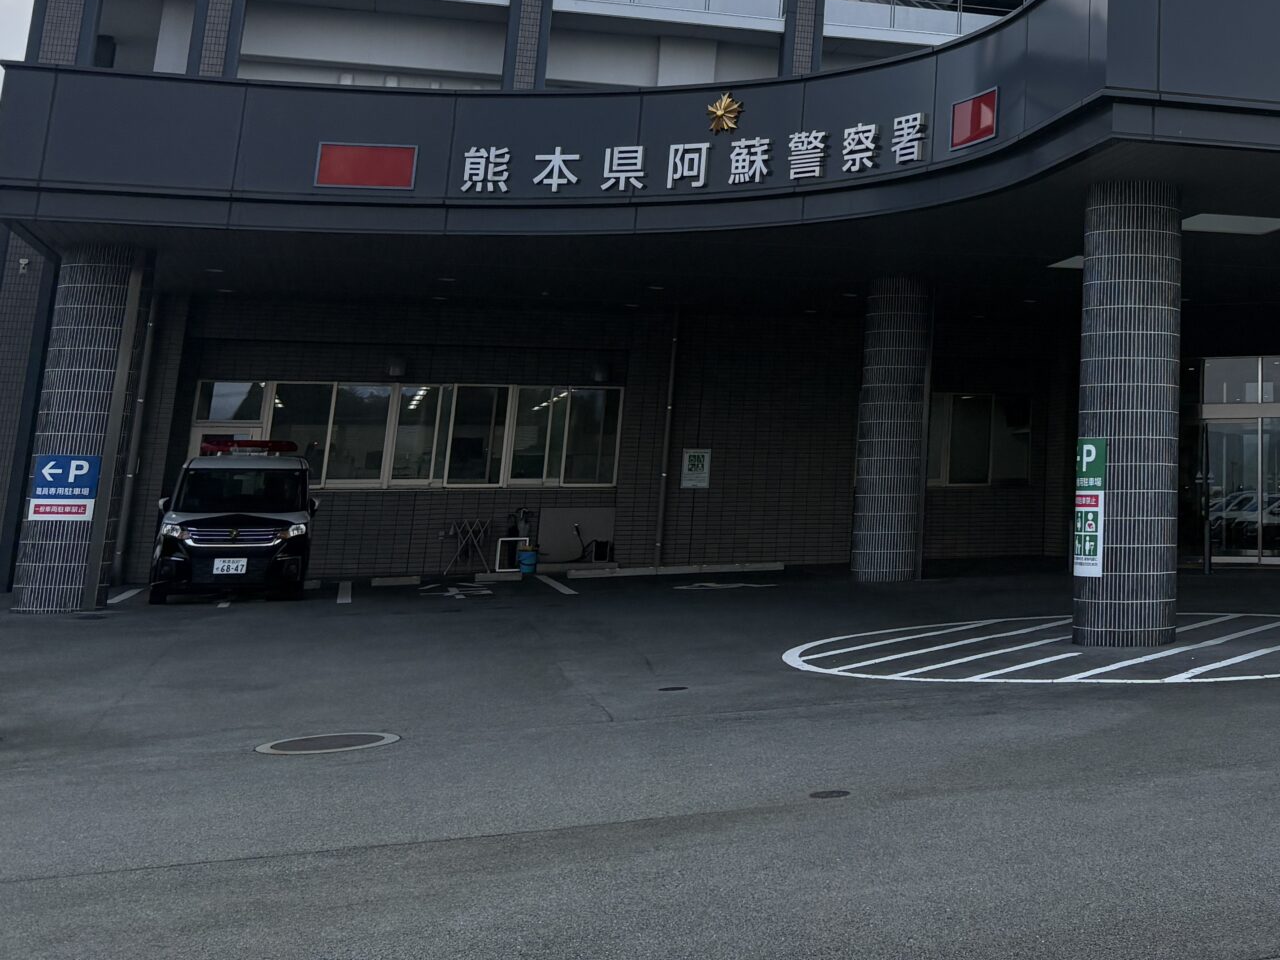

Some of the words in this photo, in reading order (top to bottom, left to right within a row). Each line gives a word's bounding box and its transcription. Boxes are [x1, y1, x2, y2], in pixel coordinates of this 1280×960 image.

[460, 112, 925, 193] 熊本県阿蘇警察署
[67, 460, 90, 483] P
[1082, 444, 1097, 472] P
